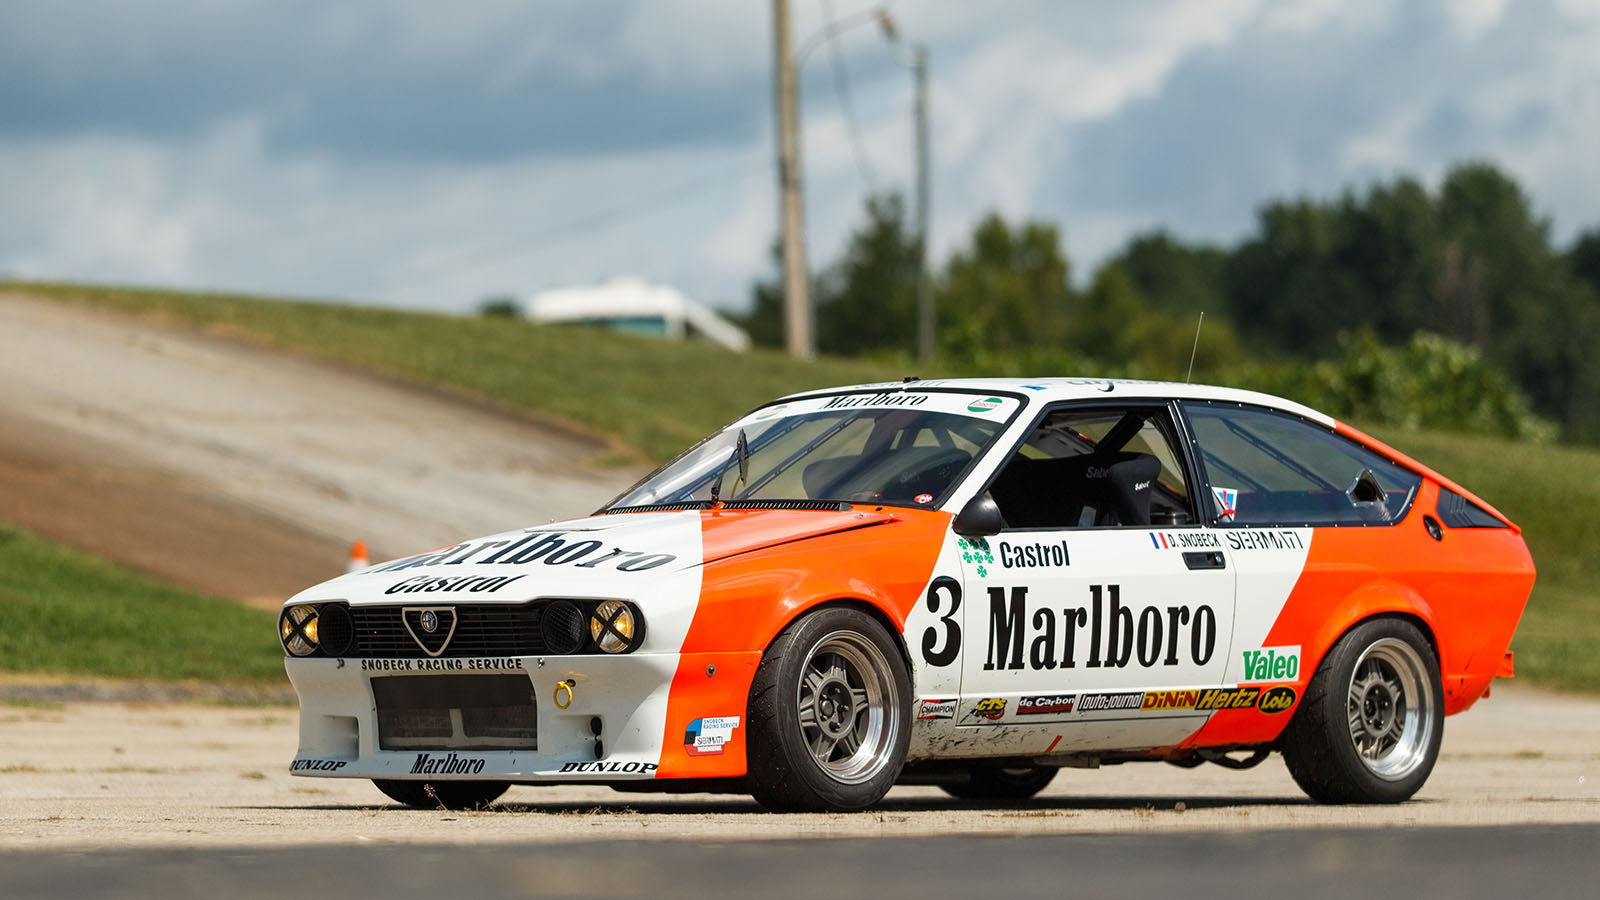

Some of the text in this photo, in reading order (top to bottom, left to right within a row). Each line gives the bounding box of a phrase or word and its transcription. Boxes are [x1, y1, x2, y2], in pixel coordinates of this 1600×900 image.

[819, 392, 928, 410] Marlboro
[1167, 533, 1221, 547] D. SNOBECK
[1226, 531, 1304, 549] SERMATI
[1000, 540, 1070, 568] Castrol
[384, 575, 529, 594] Castrol
[921, 575, 962, 667] 3
[983, 584, 1217, 671] Marlboro
[361, 658, 523, 671] SNOBECK RACING SERVICE
[1242, 650, 1298, 680] Valeo
[1019, 696, 1075, 707] de Carbon
[1198, 689, 1258, 709] Hertz
[1261, 691, 1292, 709] Lois
[922, 705, 955, 713] CHAMPION
[410, 753, 485, 775] Marlboro
[559, 762, 659, 774] DUNLOP
